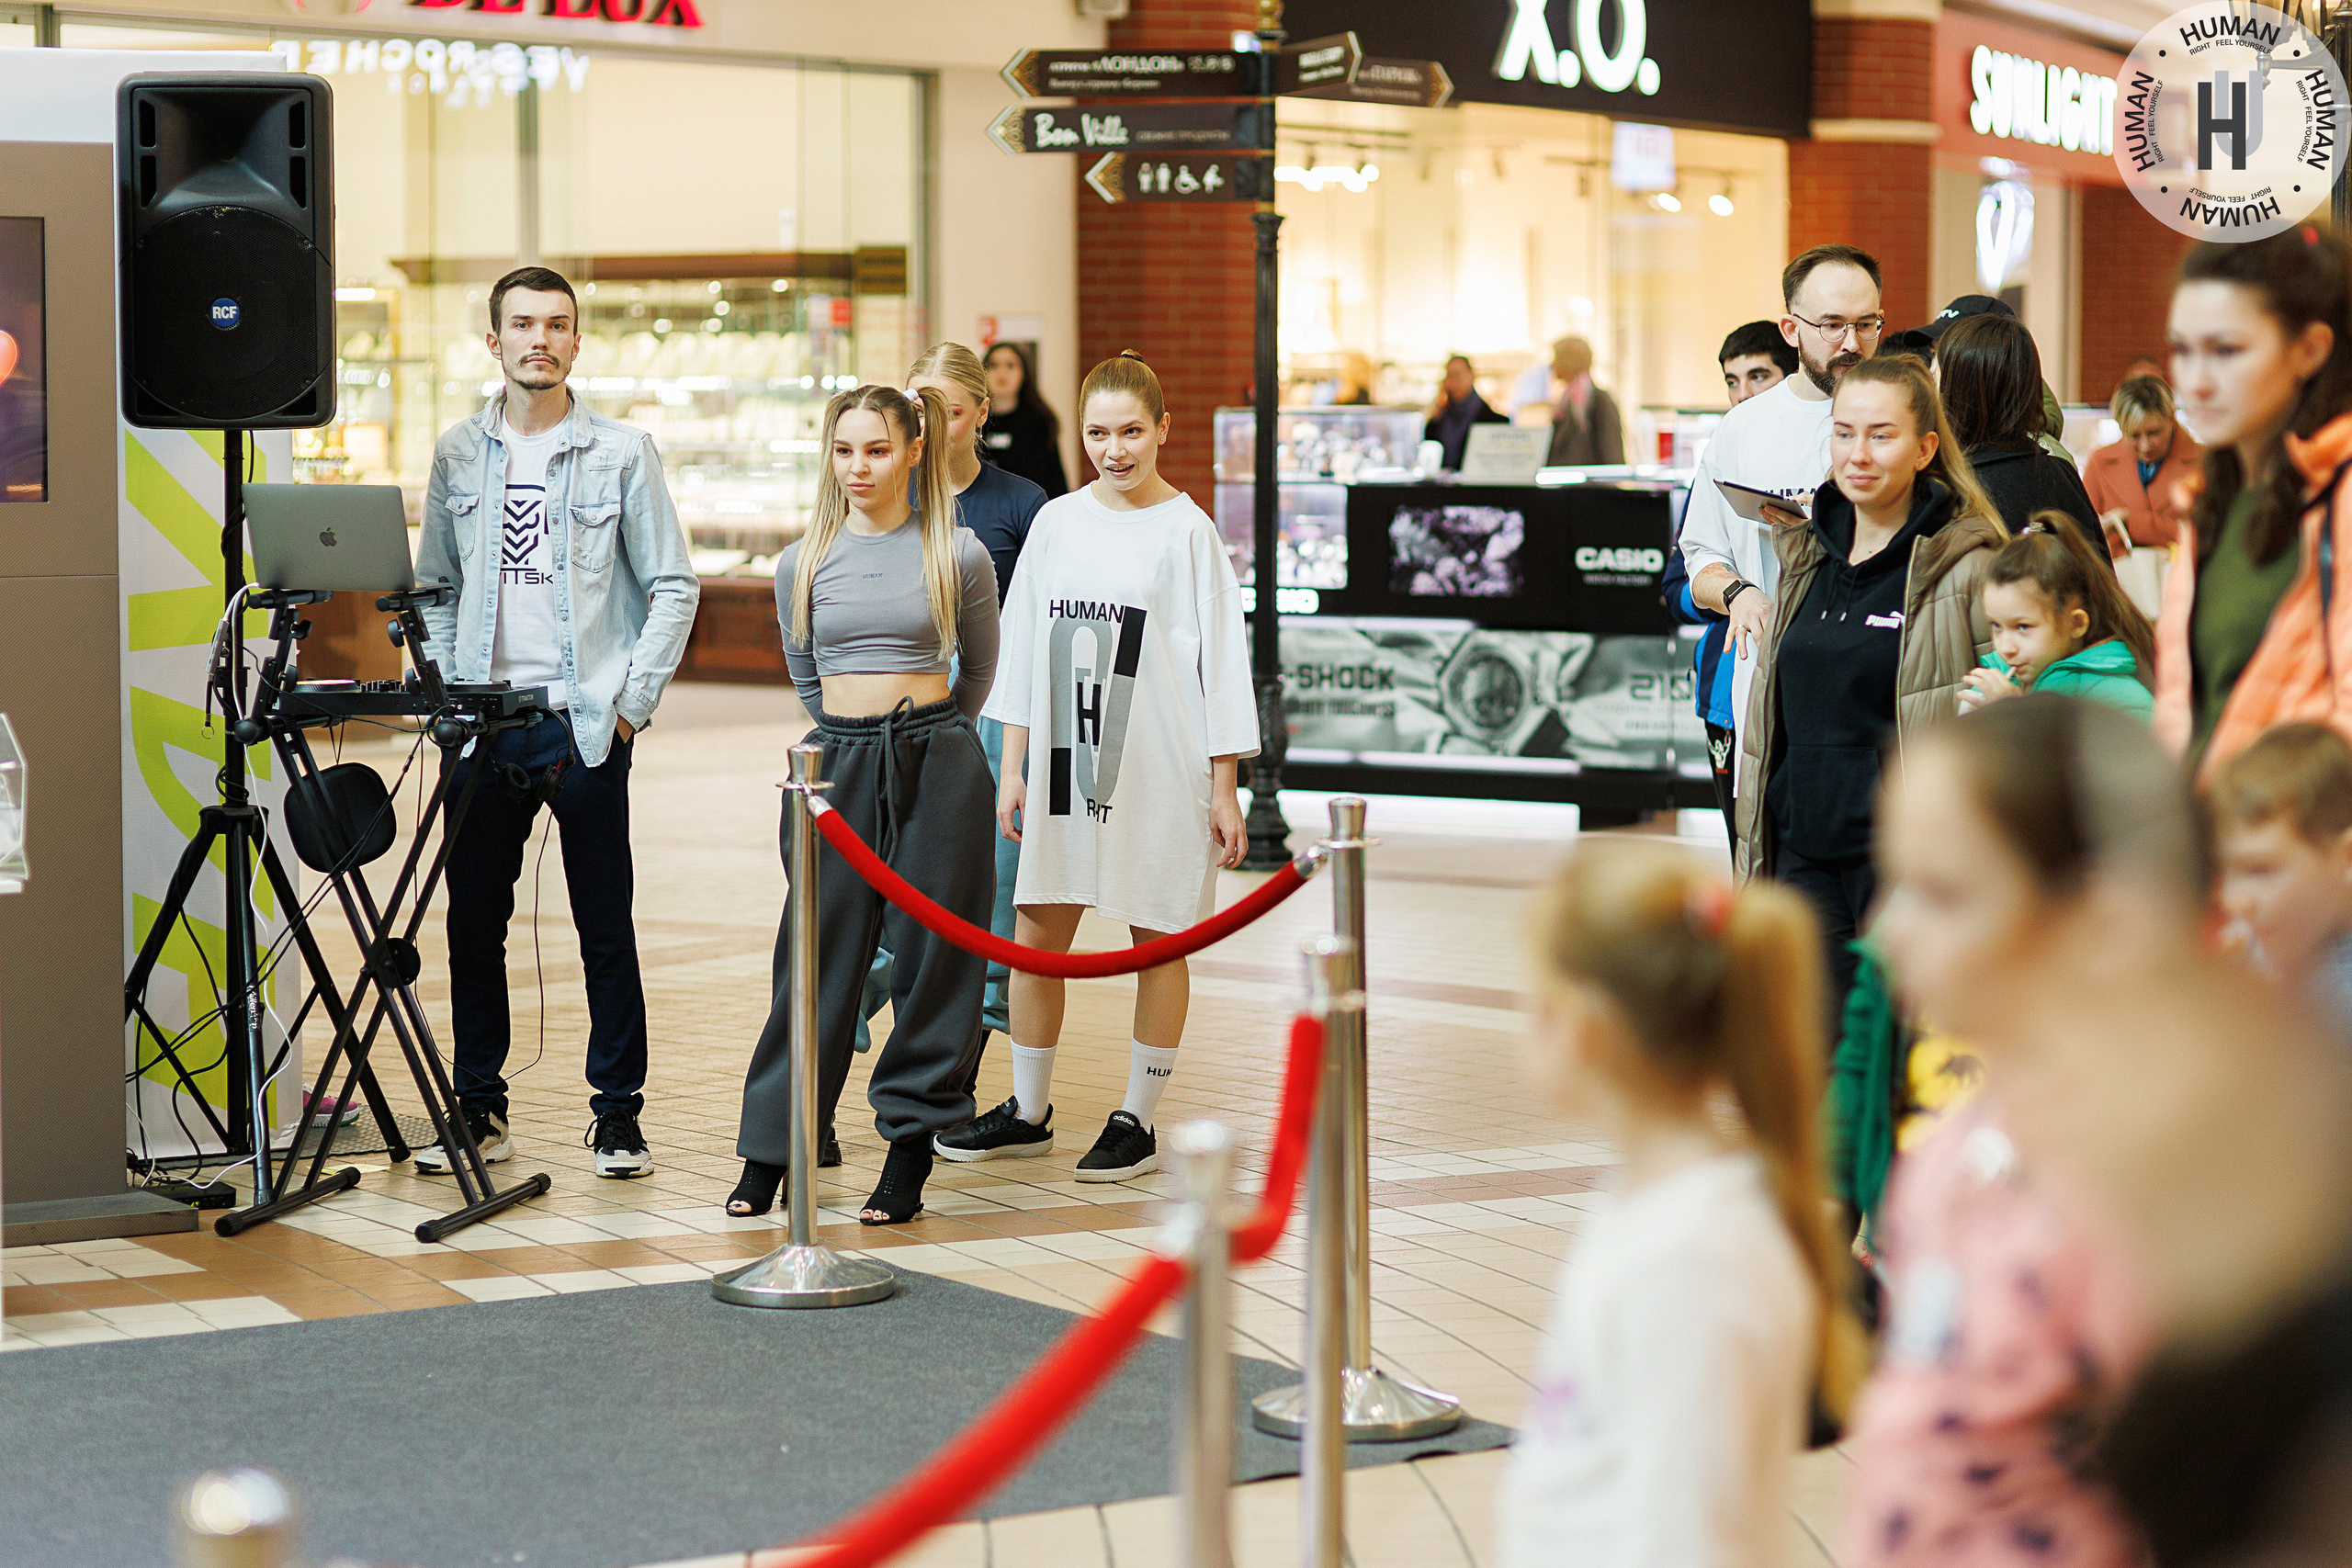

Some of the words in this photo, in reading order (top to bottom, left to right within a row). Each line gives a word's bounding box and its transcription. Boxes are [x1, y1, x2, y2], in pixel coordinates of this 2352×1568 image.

[1970, 44, 2118, 156] SUNLIGHT
[212, 306, 237, 319] RCF
[1575, 547, 1665, 572] CASIO
[1049, 599, 1125, 624] HUMAN
[1865, 615, 1900, 629] PUMA
[1286, 664, 1395, 690] -SHOCK
[1113, 1114, 1136, 1127] adidas
